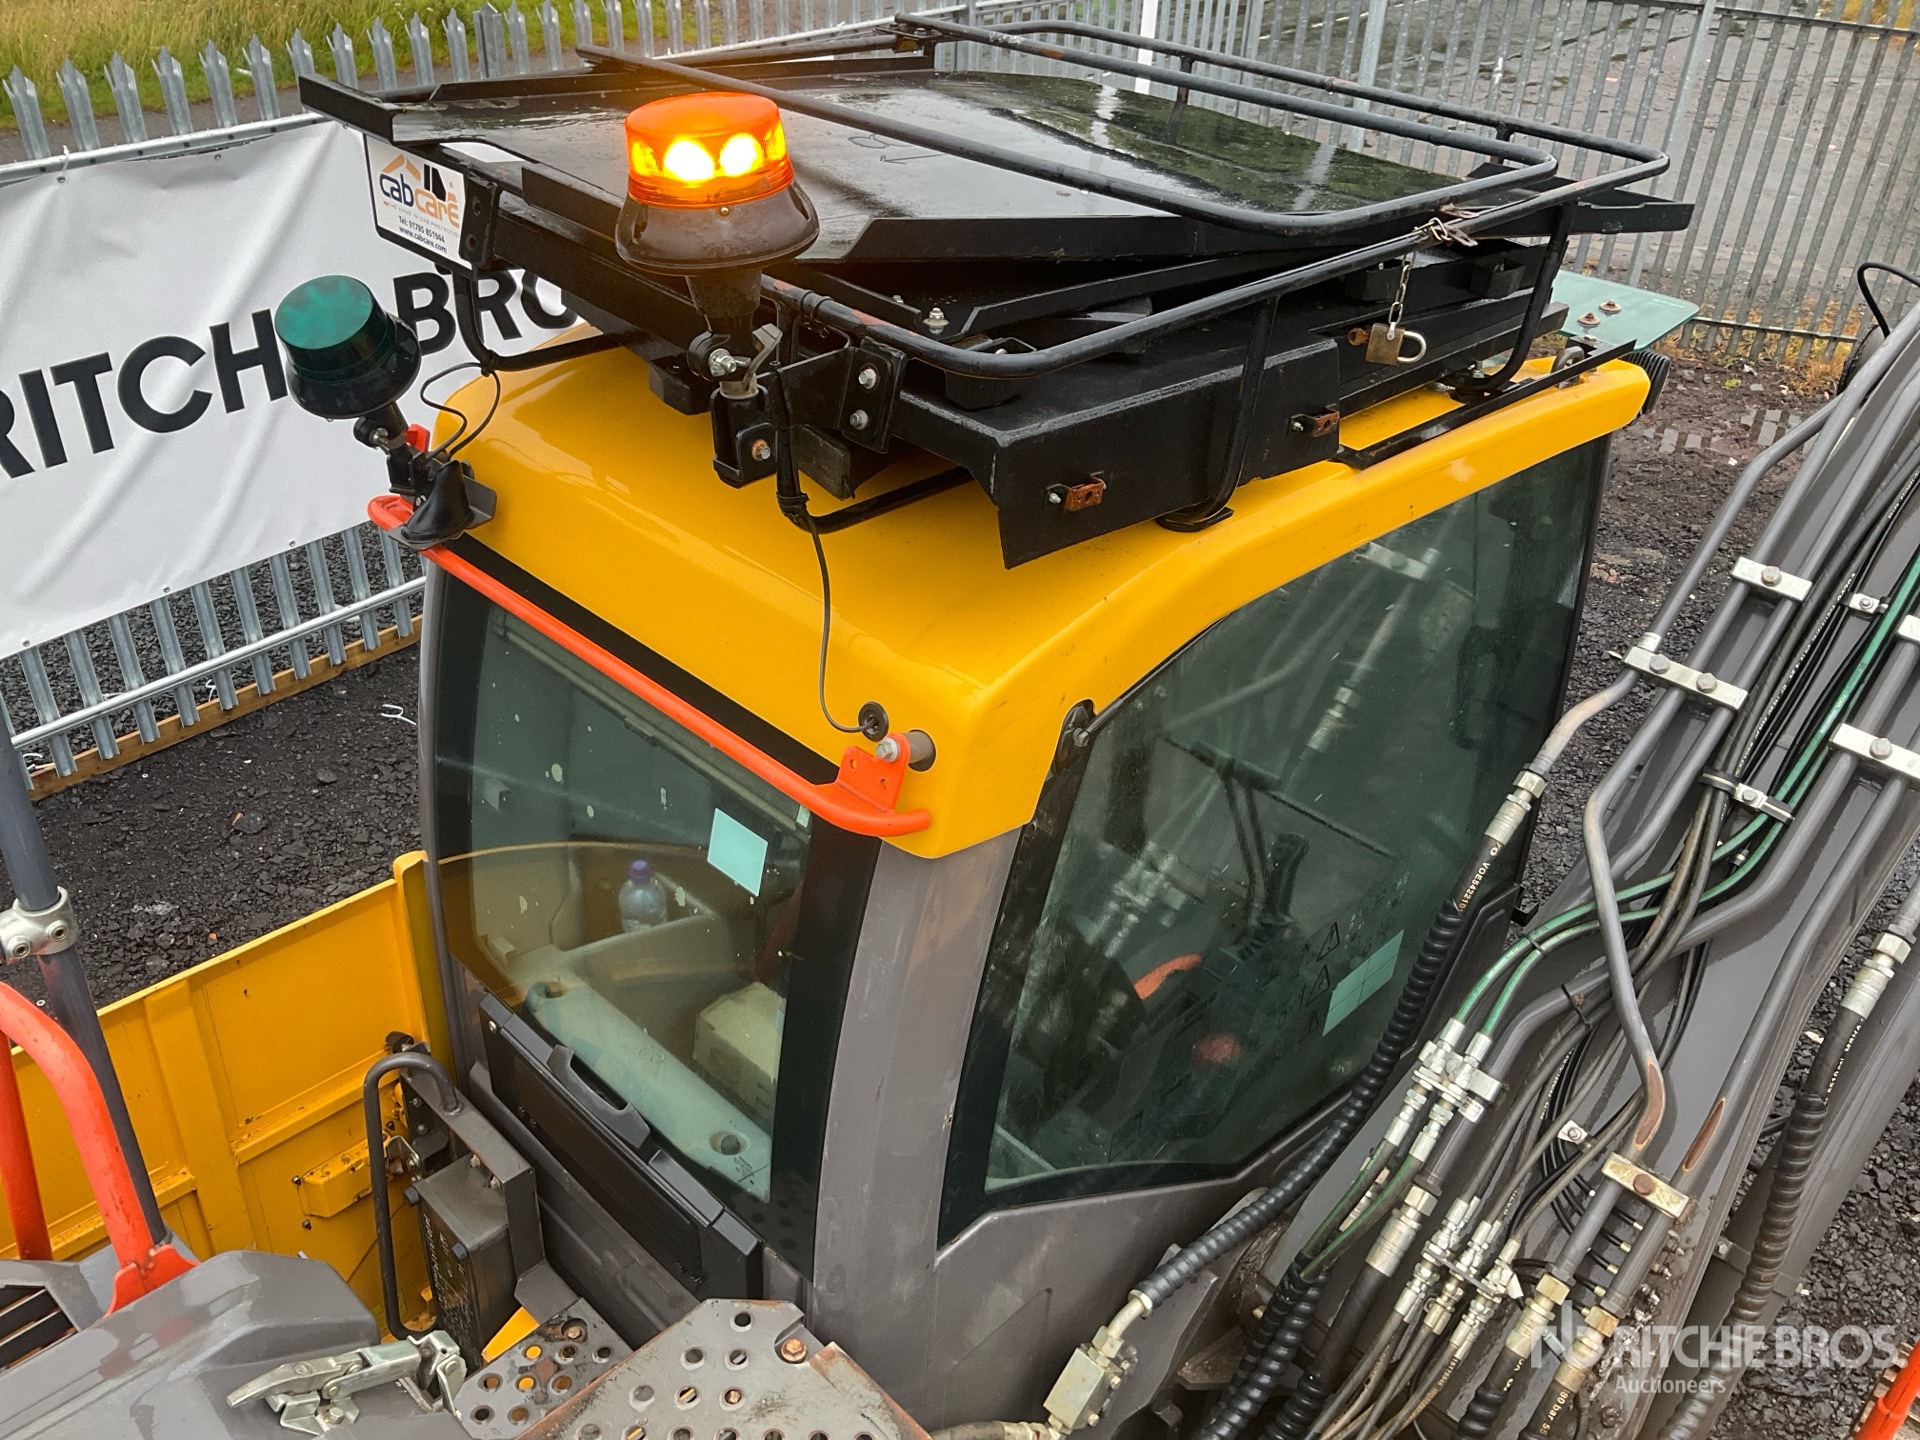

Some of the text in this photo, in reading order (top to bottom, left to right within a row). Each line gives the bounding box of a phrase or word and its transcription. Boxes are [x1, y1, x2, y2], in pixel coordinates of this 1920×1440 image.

[379, 173, 461, 229] cabcare
[398, 215, 409, 226] Tel:
[399, 226, 448, 254] www.cabcare.com
[0, 270, 577, 478] ITCH BRO
[1458, 862, 1491, 912] VOE542210
